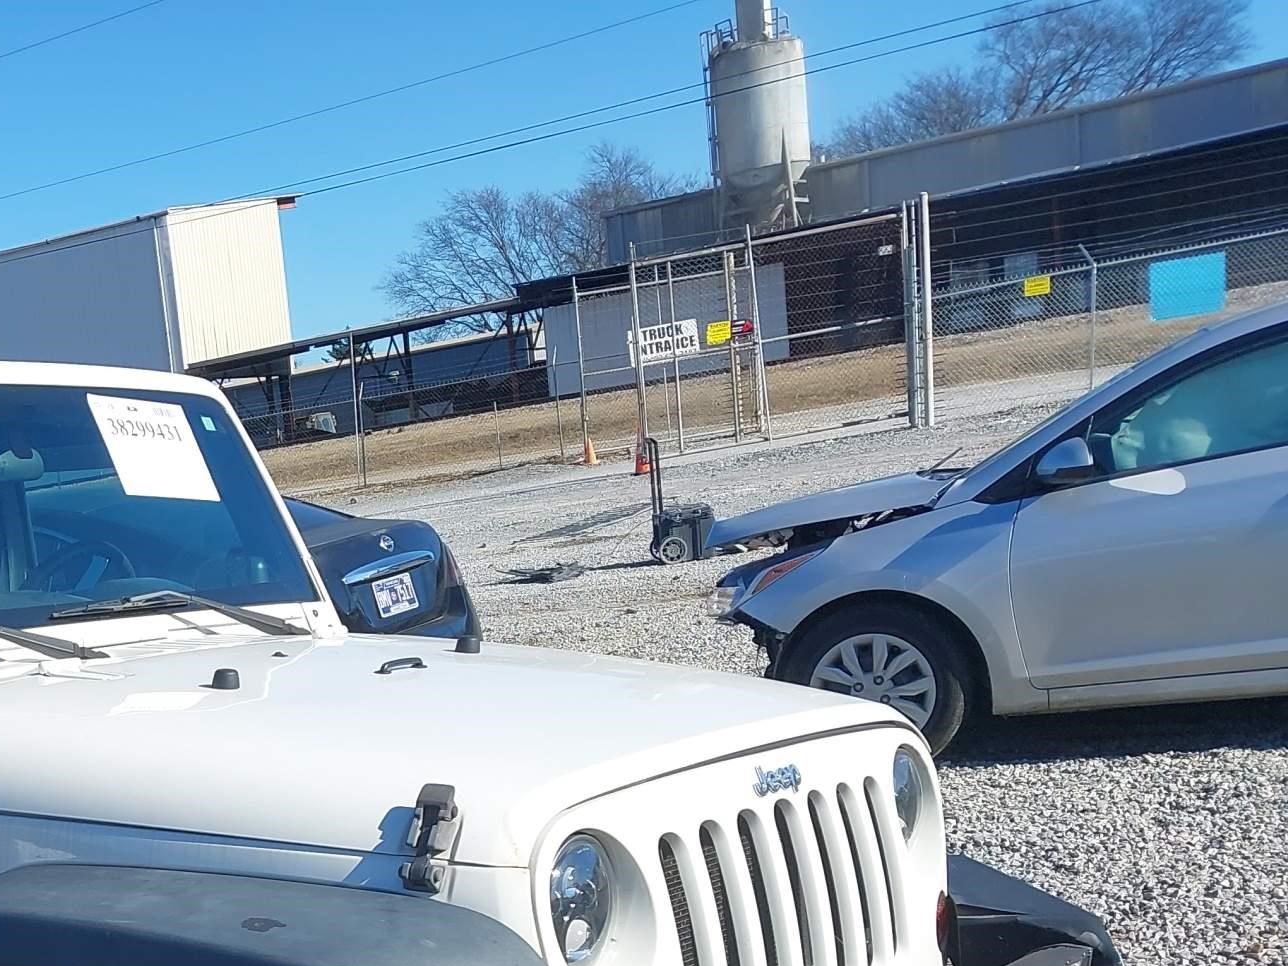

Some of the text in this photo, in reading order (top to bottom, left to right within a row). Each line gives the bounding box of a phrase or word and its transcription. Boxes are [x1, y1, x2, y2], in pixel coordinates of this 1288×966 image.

[641, 323, 684, 342] TRUCK
[107, 418, 182, 441] 38299431
[753, 763, 802, 797] Jeep
